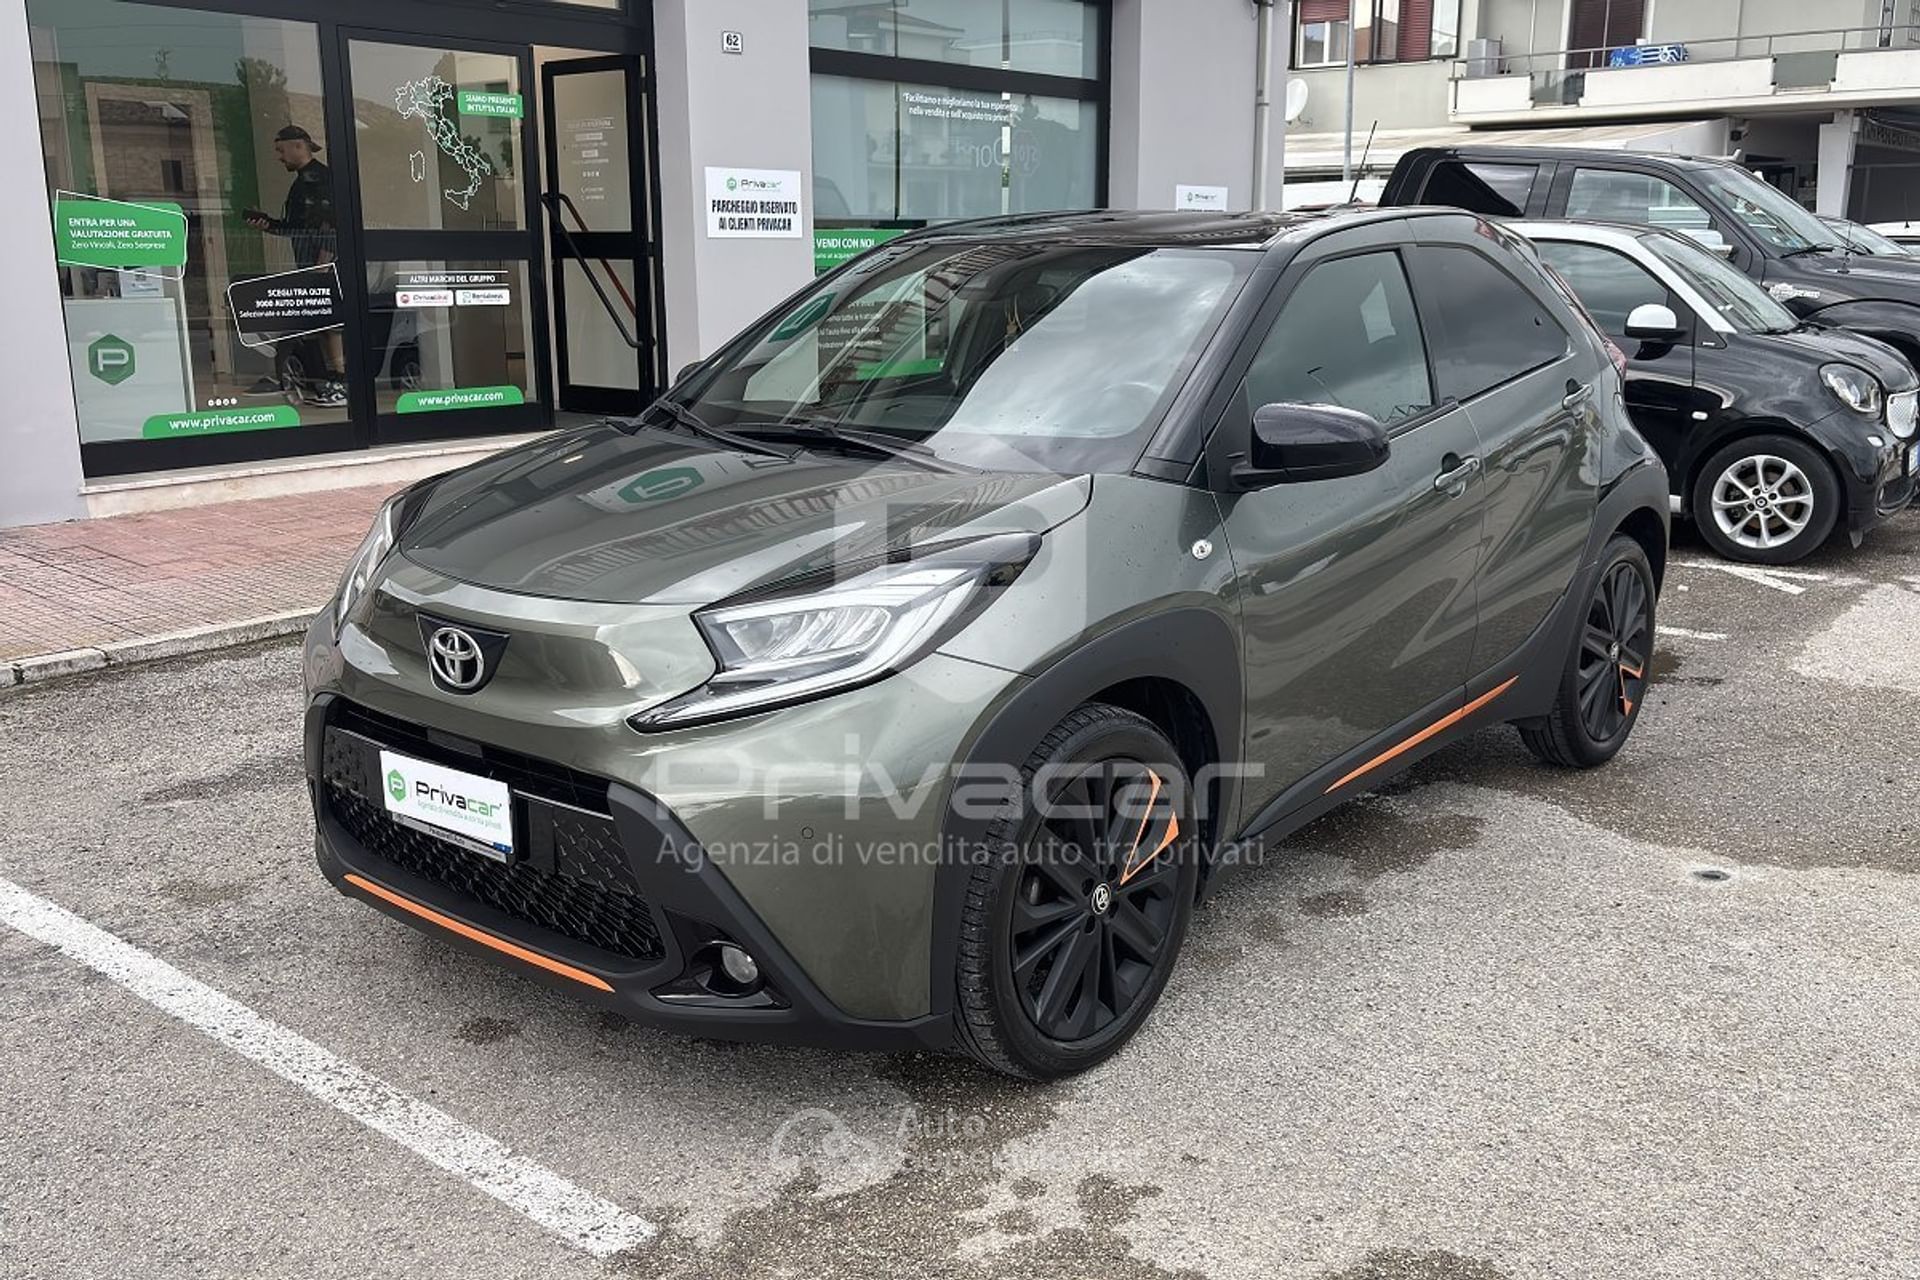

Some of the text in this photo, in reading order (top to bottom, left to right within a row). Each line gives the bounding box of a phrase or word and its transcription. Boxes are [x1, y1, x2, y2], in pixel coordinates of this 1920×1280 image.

[726, 34, 739, 46] 62
[712, 200, 798, 214] PARCHEGGIO RISERVATO
[68, 218, 136, 227] ENTRA PER UNA
[719, 217, 791, 231] AI CLIENTI PRIVACAR
[70, 230, 172, 239] VALUTAZIONE GRATUITA
[72, 241, 88, 249] Zero
[117, 241, 134, 249] Zero
[135, 241, 166, 250] Sorprese
[816, 238, 840, 248] VENDI
[841, 238, 858, 248] CON
[410, 275, 496, 284] ALTRI MARCHI DEL GRUPPO
[267, 288, 331, 297] SCEGLI TRA OLTRE
[275, 299, 295, 307] AUTO
[305, 298, 332, 306] PRIVATI
[418, 391, 504, 406] www.privacar.com
[169, 412, 275, 429] www.privacar.com
[416, 781, 502, 817] Privacar
